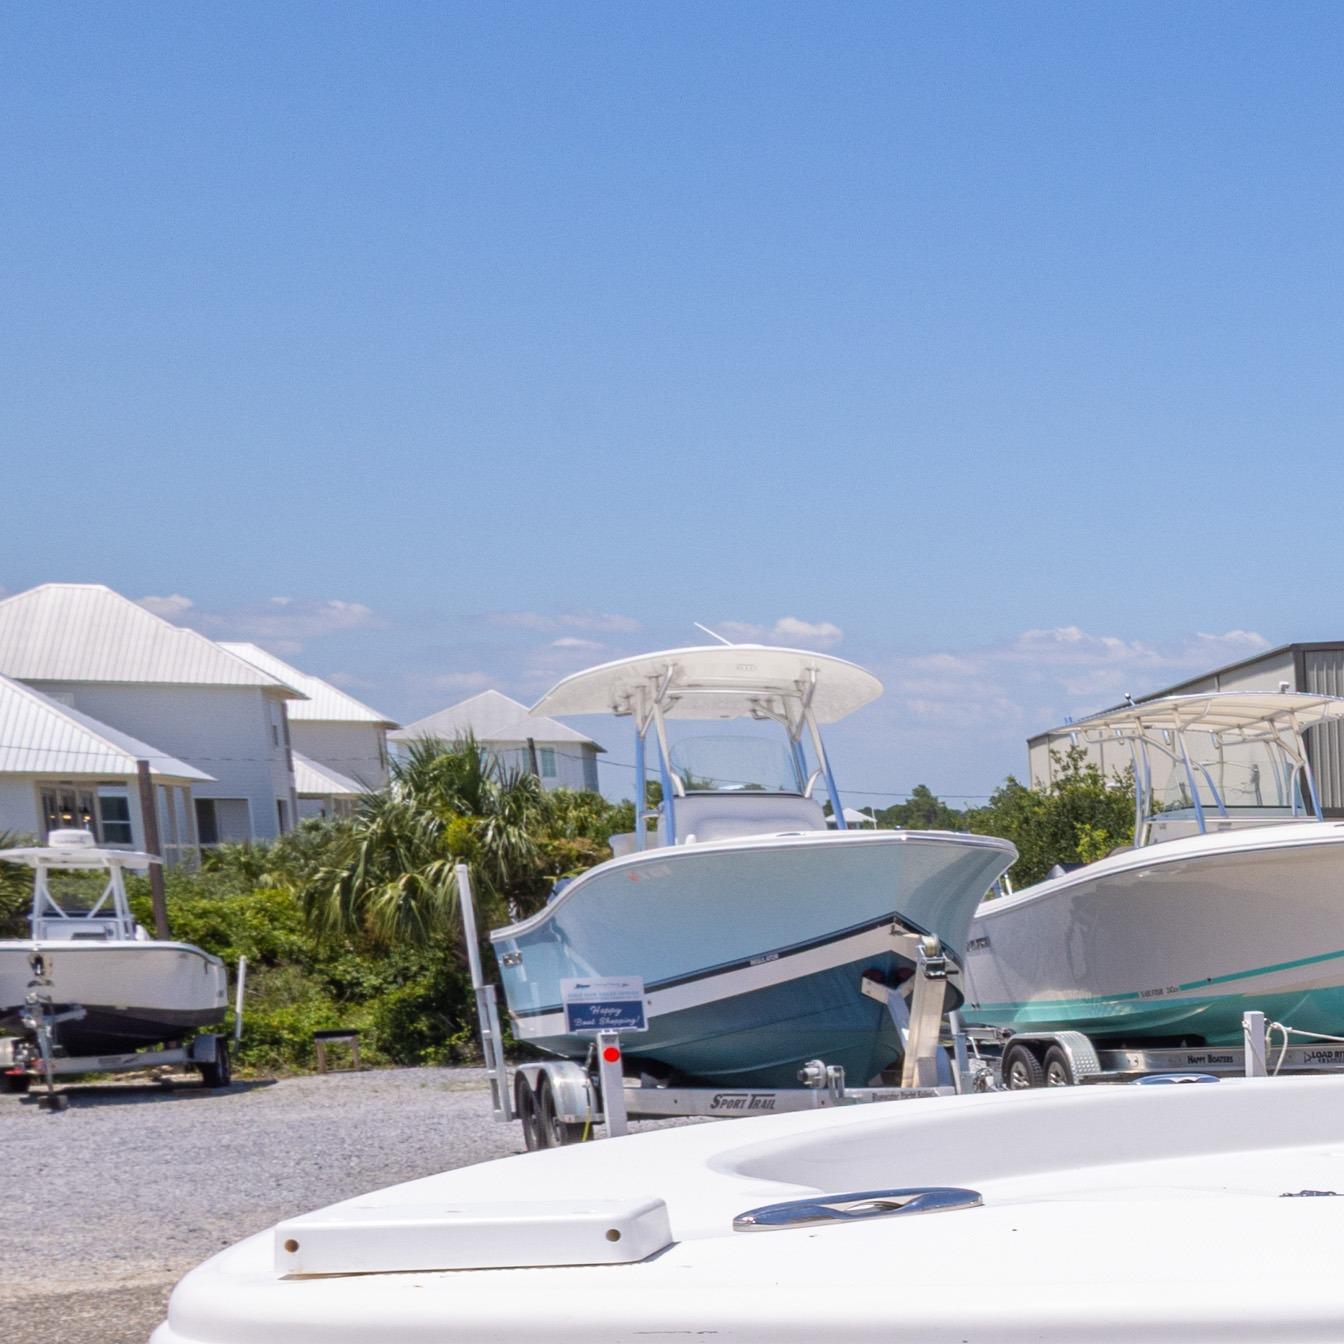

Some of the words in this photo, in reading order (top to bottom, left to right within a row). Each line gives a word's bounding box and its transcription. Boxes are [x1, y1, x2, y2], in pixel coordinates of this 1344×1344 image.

[590, 1005, 622, 1017] Happy
[574, 1017, 596, 1027] Boat
[1311, 1050, 1334, 1058] LOAD
[710, 1093, 749, 1110] SPORT
[747, 1093, 777, 1110] TRAIL
